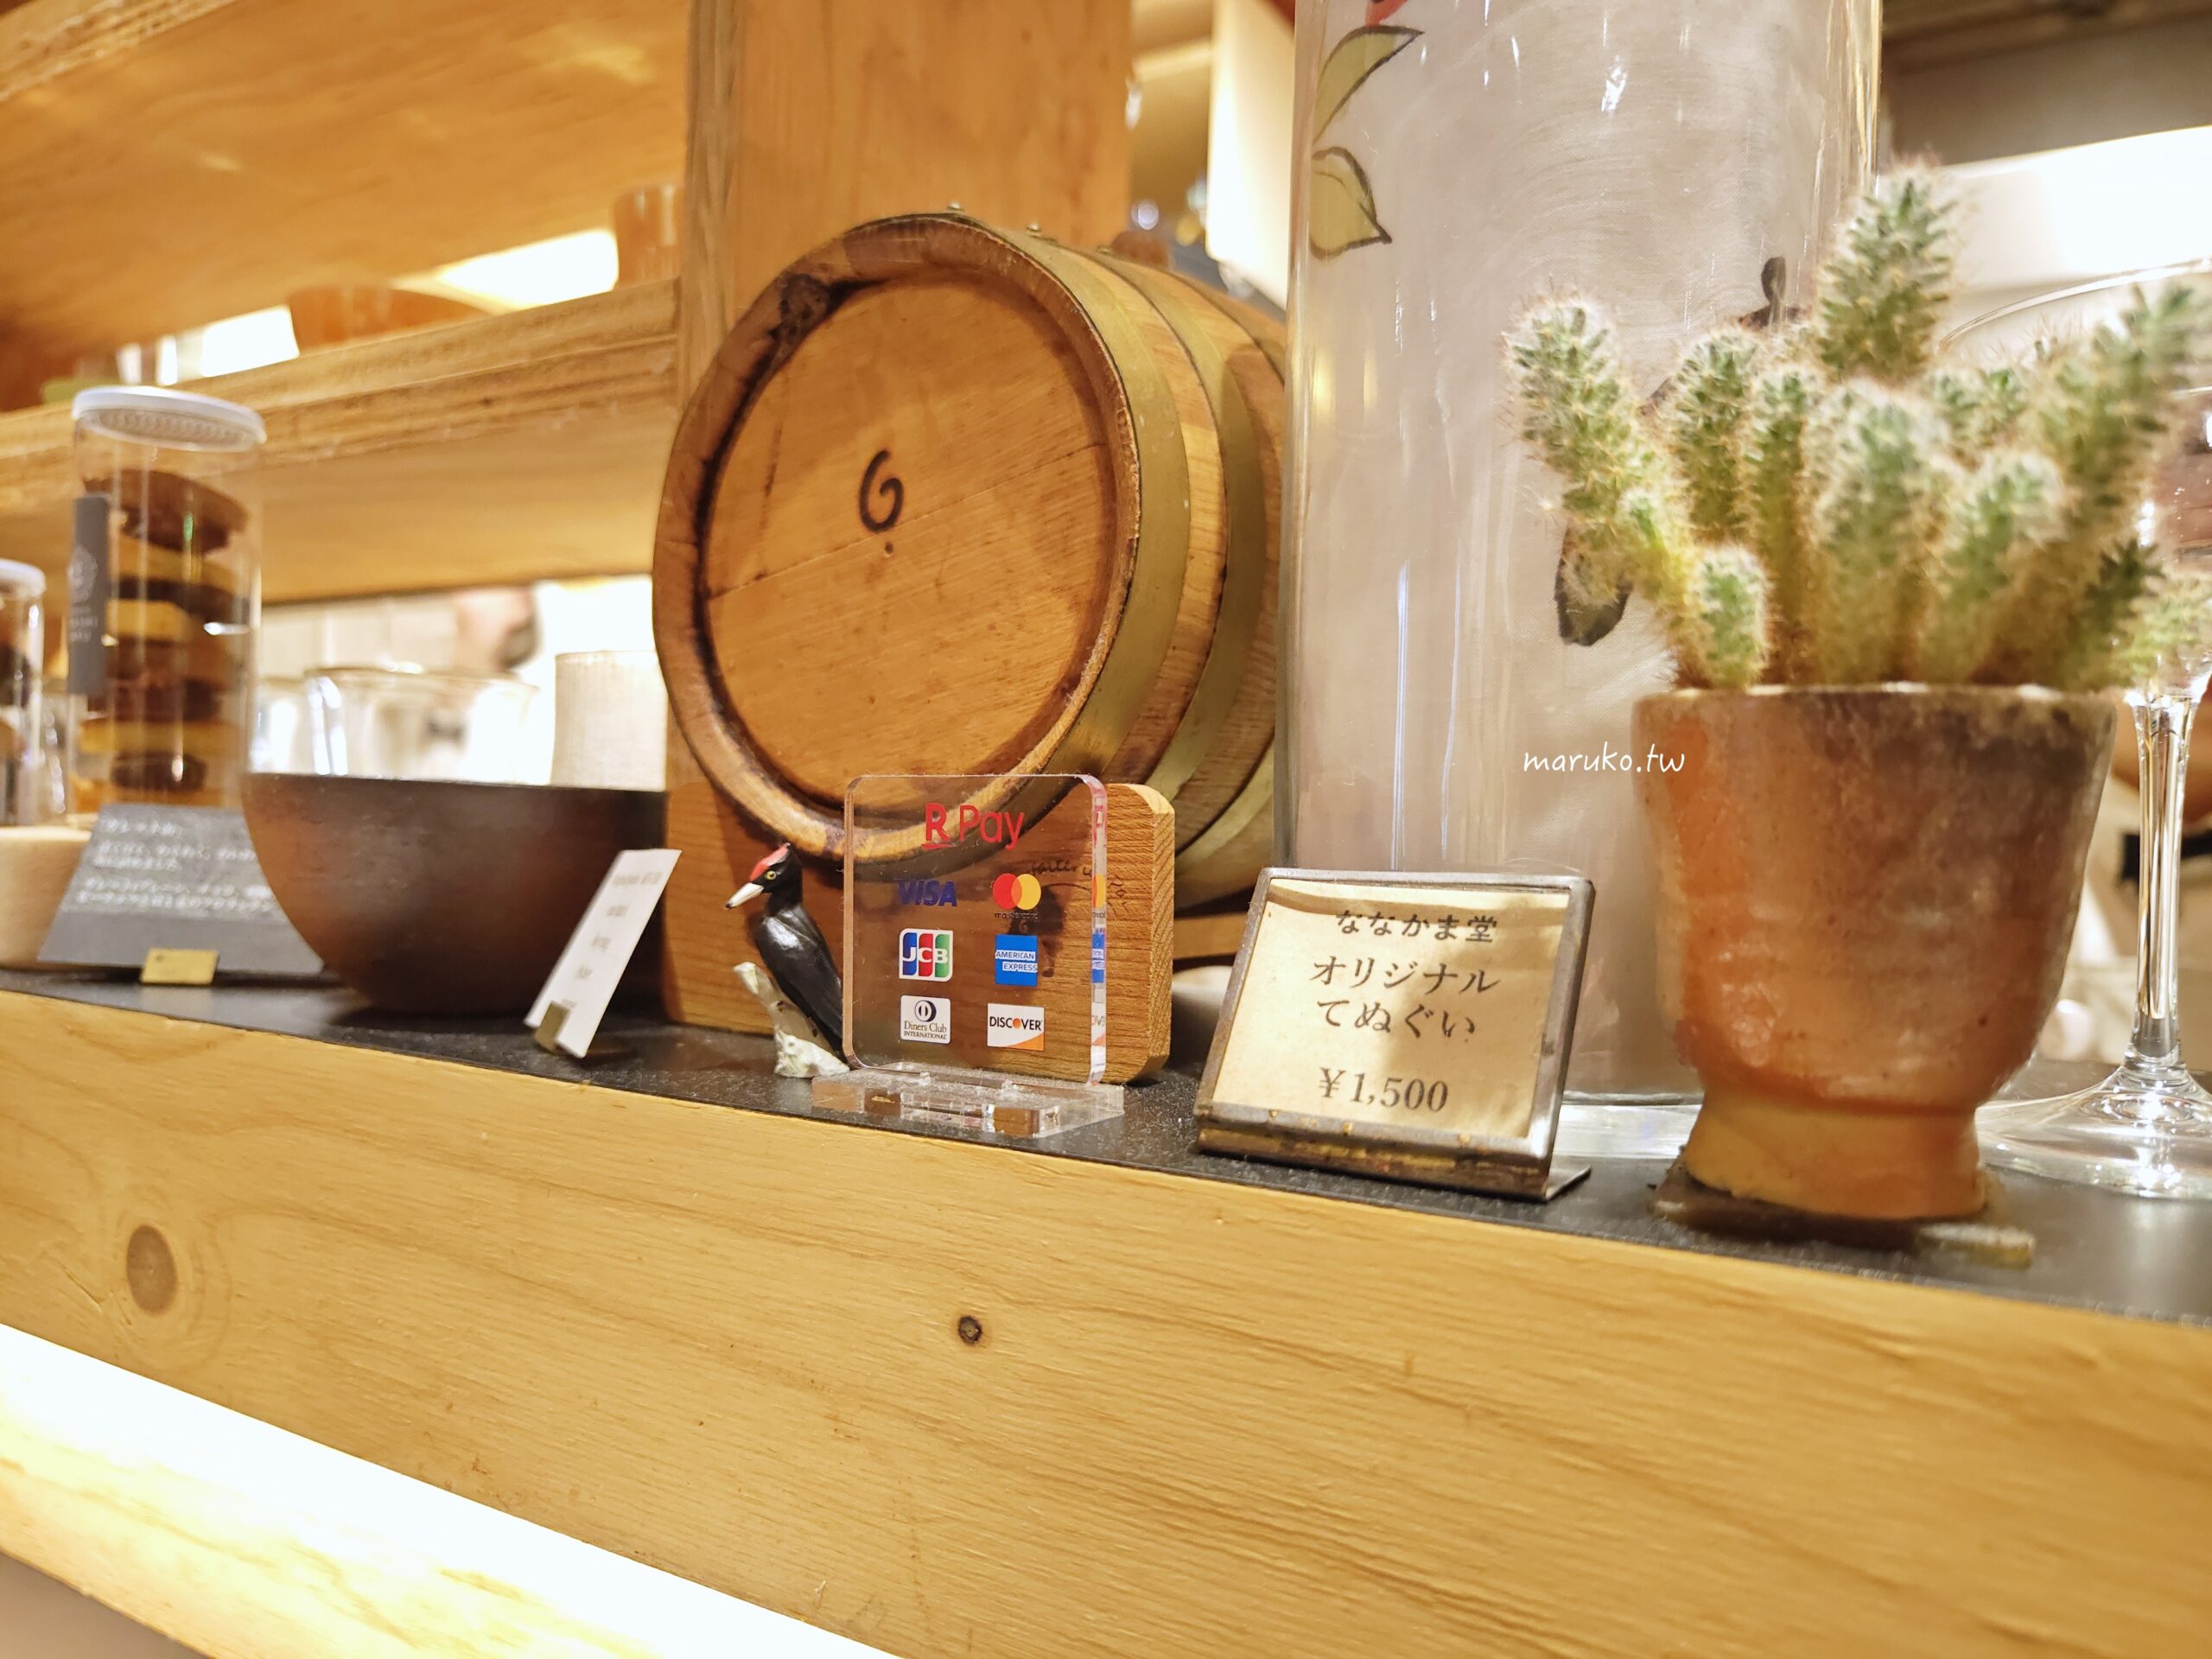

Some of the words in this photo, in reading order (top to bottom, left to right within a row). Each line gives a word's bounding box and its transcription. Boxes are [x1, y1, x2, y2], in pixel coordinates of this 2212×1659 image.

[921, 802, 956, 850] R
[959, 804, 1025, 851] Pay
[898, 878, 957, 907] VISA
[1337, 908, 1498, 944] ななかま堂
[903, 947, 948, 963] JCB
[996, 950, 1034, 960] AMERICAN
[1003, 963, 1037, 972] EXPRESS
[1309, 956, 1500, 995] オリジナル
[904, 1020, 928, 1032] Diners
[929, 1023, 947, 1033] Club
[989, 1016, 1042, 1031] DISCOVER
[1317, 999, 1475, 1039] てぬぐい
[904, 1031, 947, 1040] INTERNATIONAL
[1318, 1067, 1448, 1113] ¥1,500
